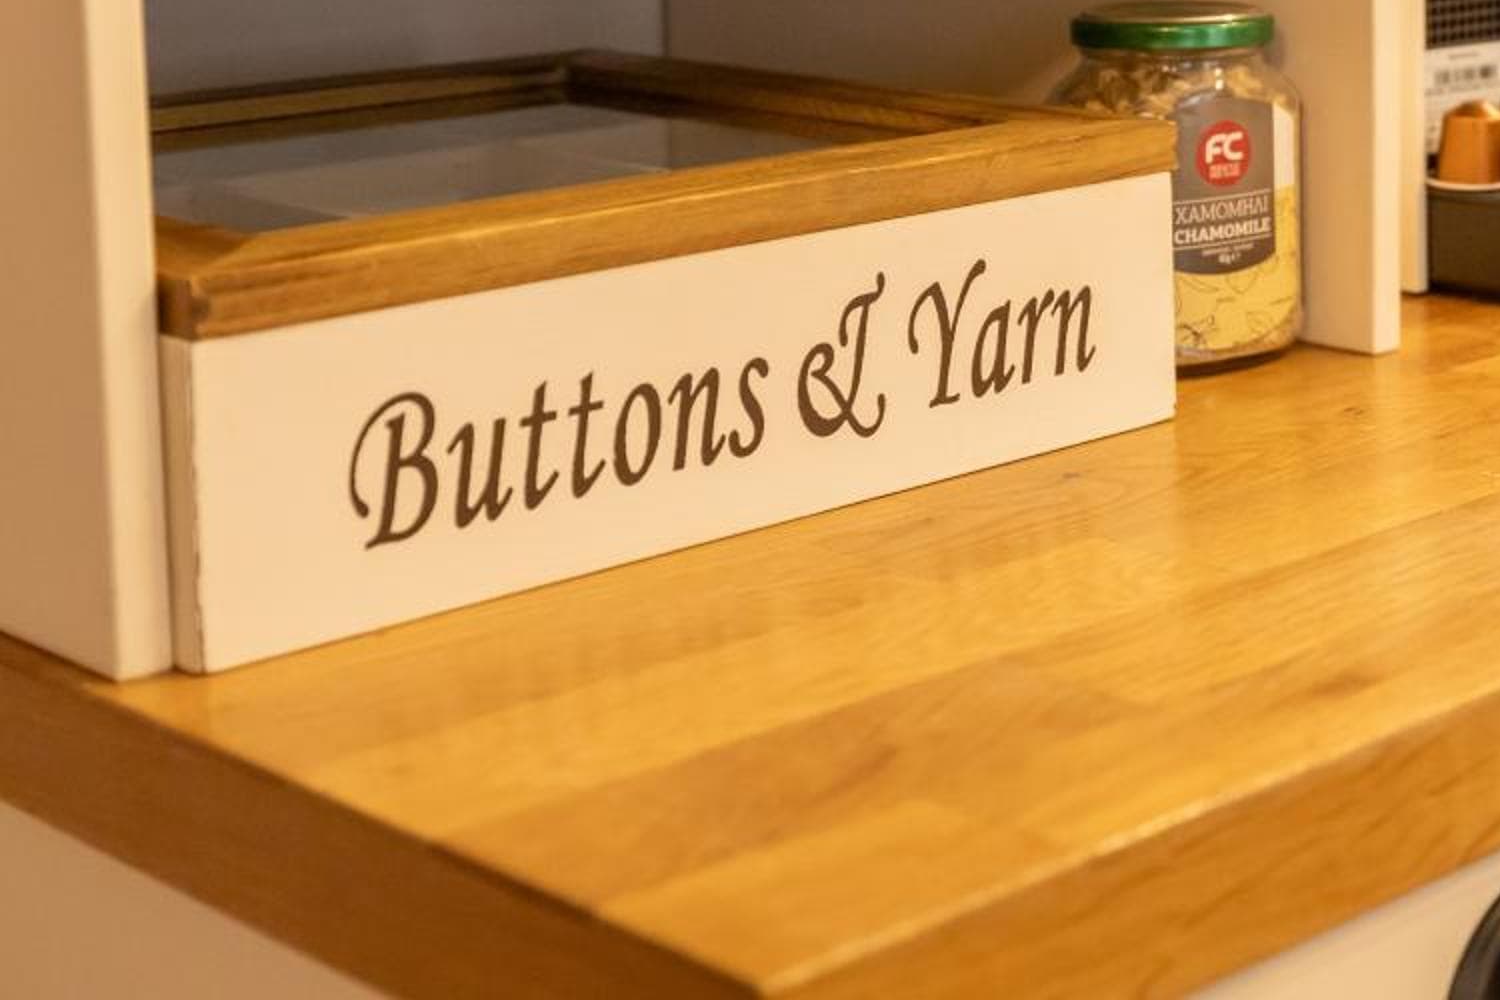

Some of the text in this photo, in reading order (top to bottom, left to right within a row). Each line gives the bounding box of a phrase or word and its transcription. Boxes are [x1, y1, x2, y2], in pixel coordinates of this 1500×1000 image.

[1205, 131, 1245, 164] FC
[1174, 217, 1272, 245] CHAMOMILE
[348, 258, 1096, 550] Buttons & Yarn
